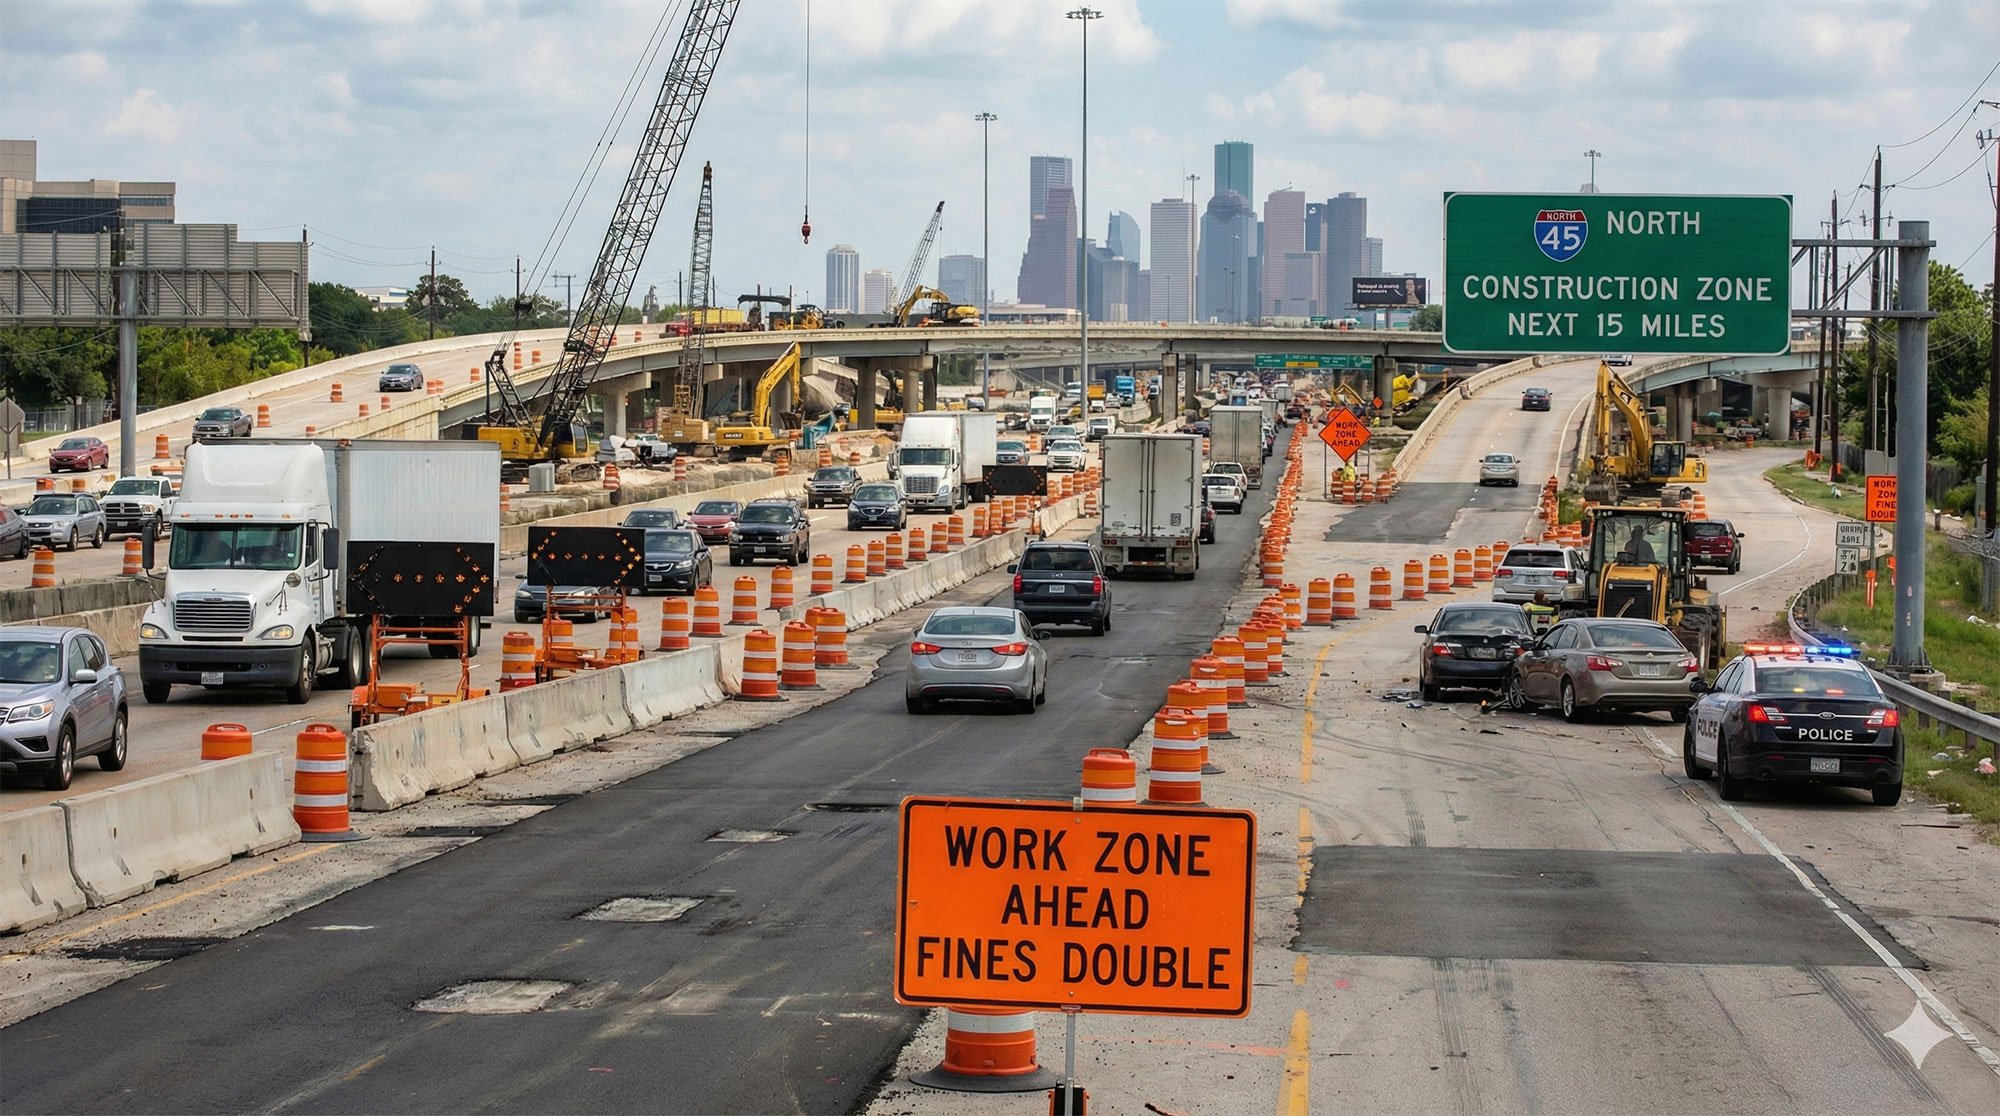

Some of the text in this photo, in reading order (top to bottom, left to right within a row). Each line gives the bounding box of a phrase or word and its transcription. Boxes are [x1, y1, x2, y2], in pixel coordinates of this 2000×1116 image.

[1546, 212, 1576, 221] NORTH
[1607, 210, 1701, 235] NORTH
[1541, 225, 1581, 251] 45
[1463, 275, 1772, 301] CONSTRUCTION ZONE
[1508, 312, 1726, 338] NEXT 15 MILES
[1335, 430, 1357, 438] ZONE
[1877, 490, 1897, 499] ZON
[1798, 727, 1854, 741] POLICE
[944, 825, 1212, 877] WORK ZONE
[1001, 884, 1150, 930] AHEAD
[916, 936, 1231, 990] FINES DOUBLE
